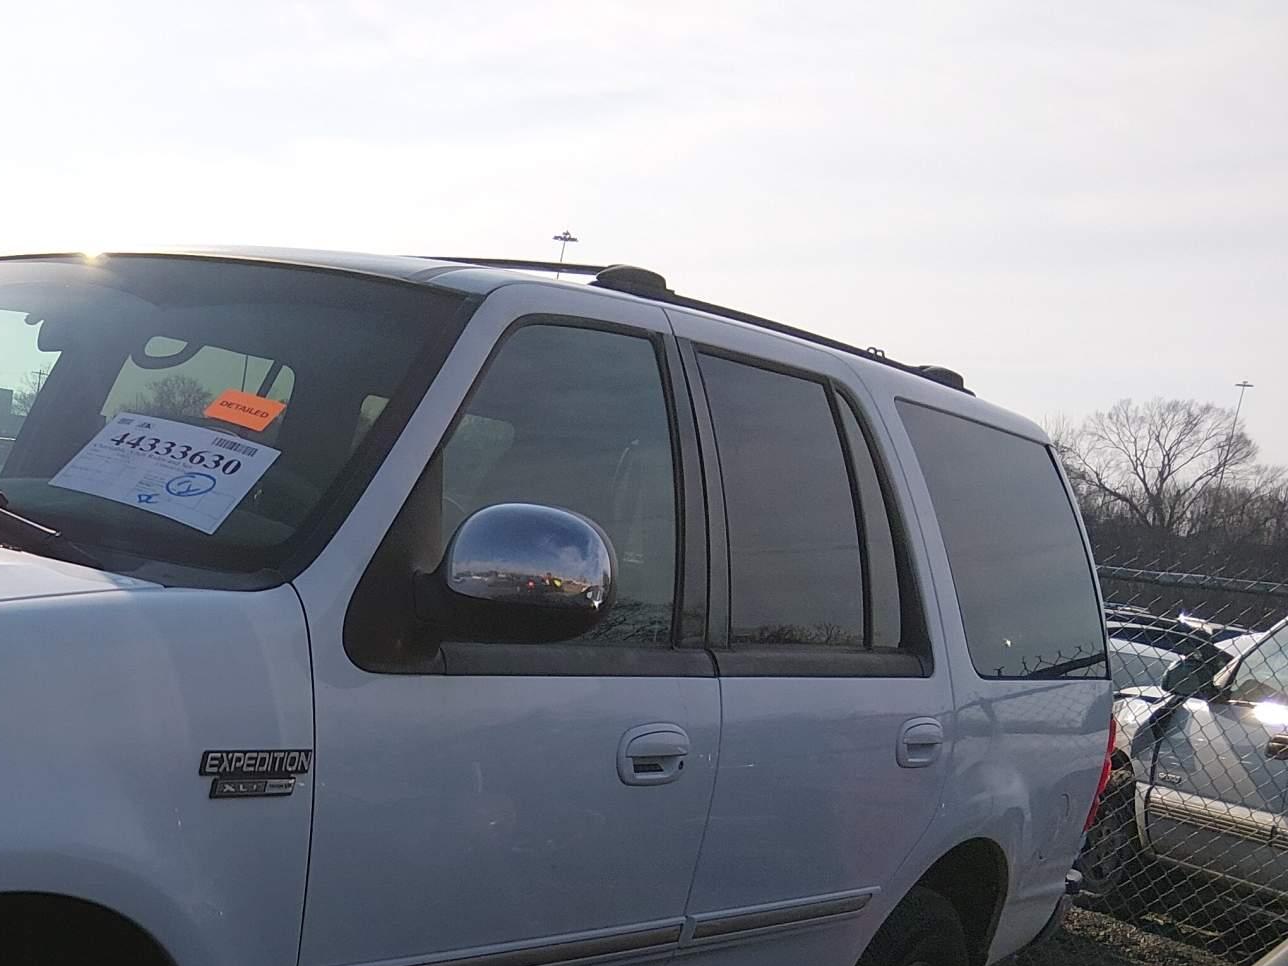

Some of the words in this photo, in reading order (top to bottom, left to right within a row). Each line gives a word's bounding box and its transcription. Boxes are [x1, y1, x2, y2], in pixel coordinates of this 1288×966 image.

[219, 400, 269, 418] DETAILED
[110, 432, 242, 475] 44333630
[205, 752, 312, 773] EXPEDITION
